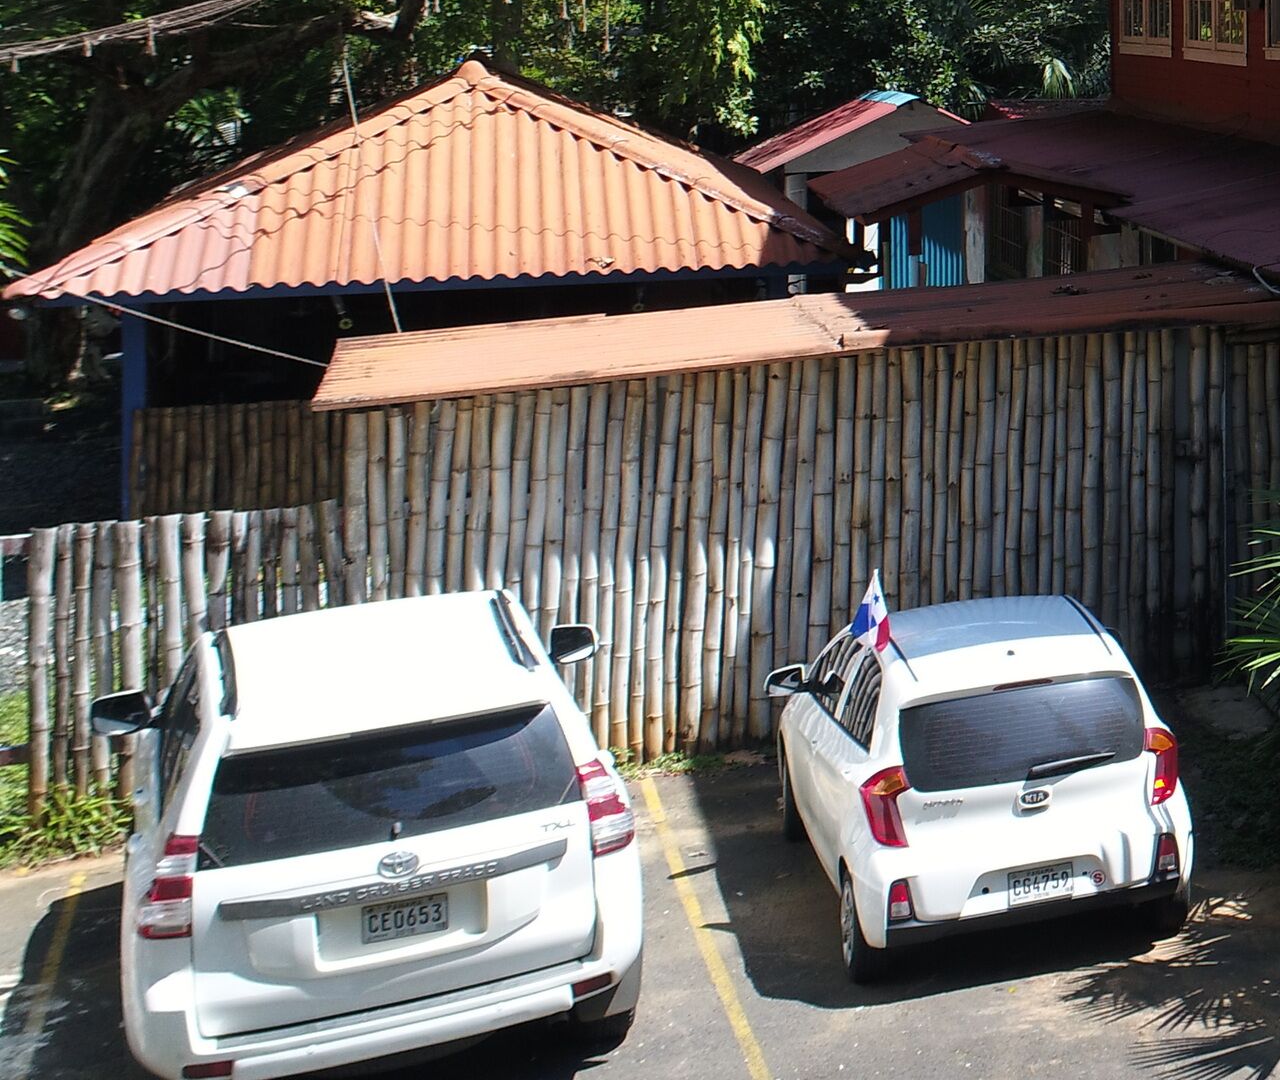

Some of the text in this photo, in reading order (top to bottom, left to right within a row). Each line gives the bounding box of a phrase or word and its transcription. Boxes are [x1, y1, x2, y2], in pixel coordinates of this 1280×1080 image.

[1024, 792, 1045, 803] KIA
[301, 861, 499, 909] LAND CRUISER PRADO
[1013, 871, 1069, 896] CG4759
